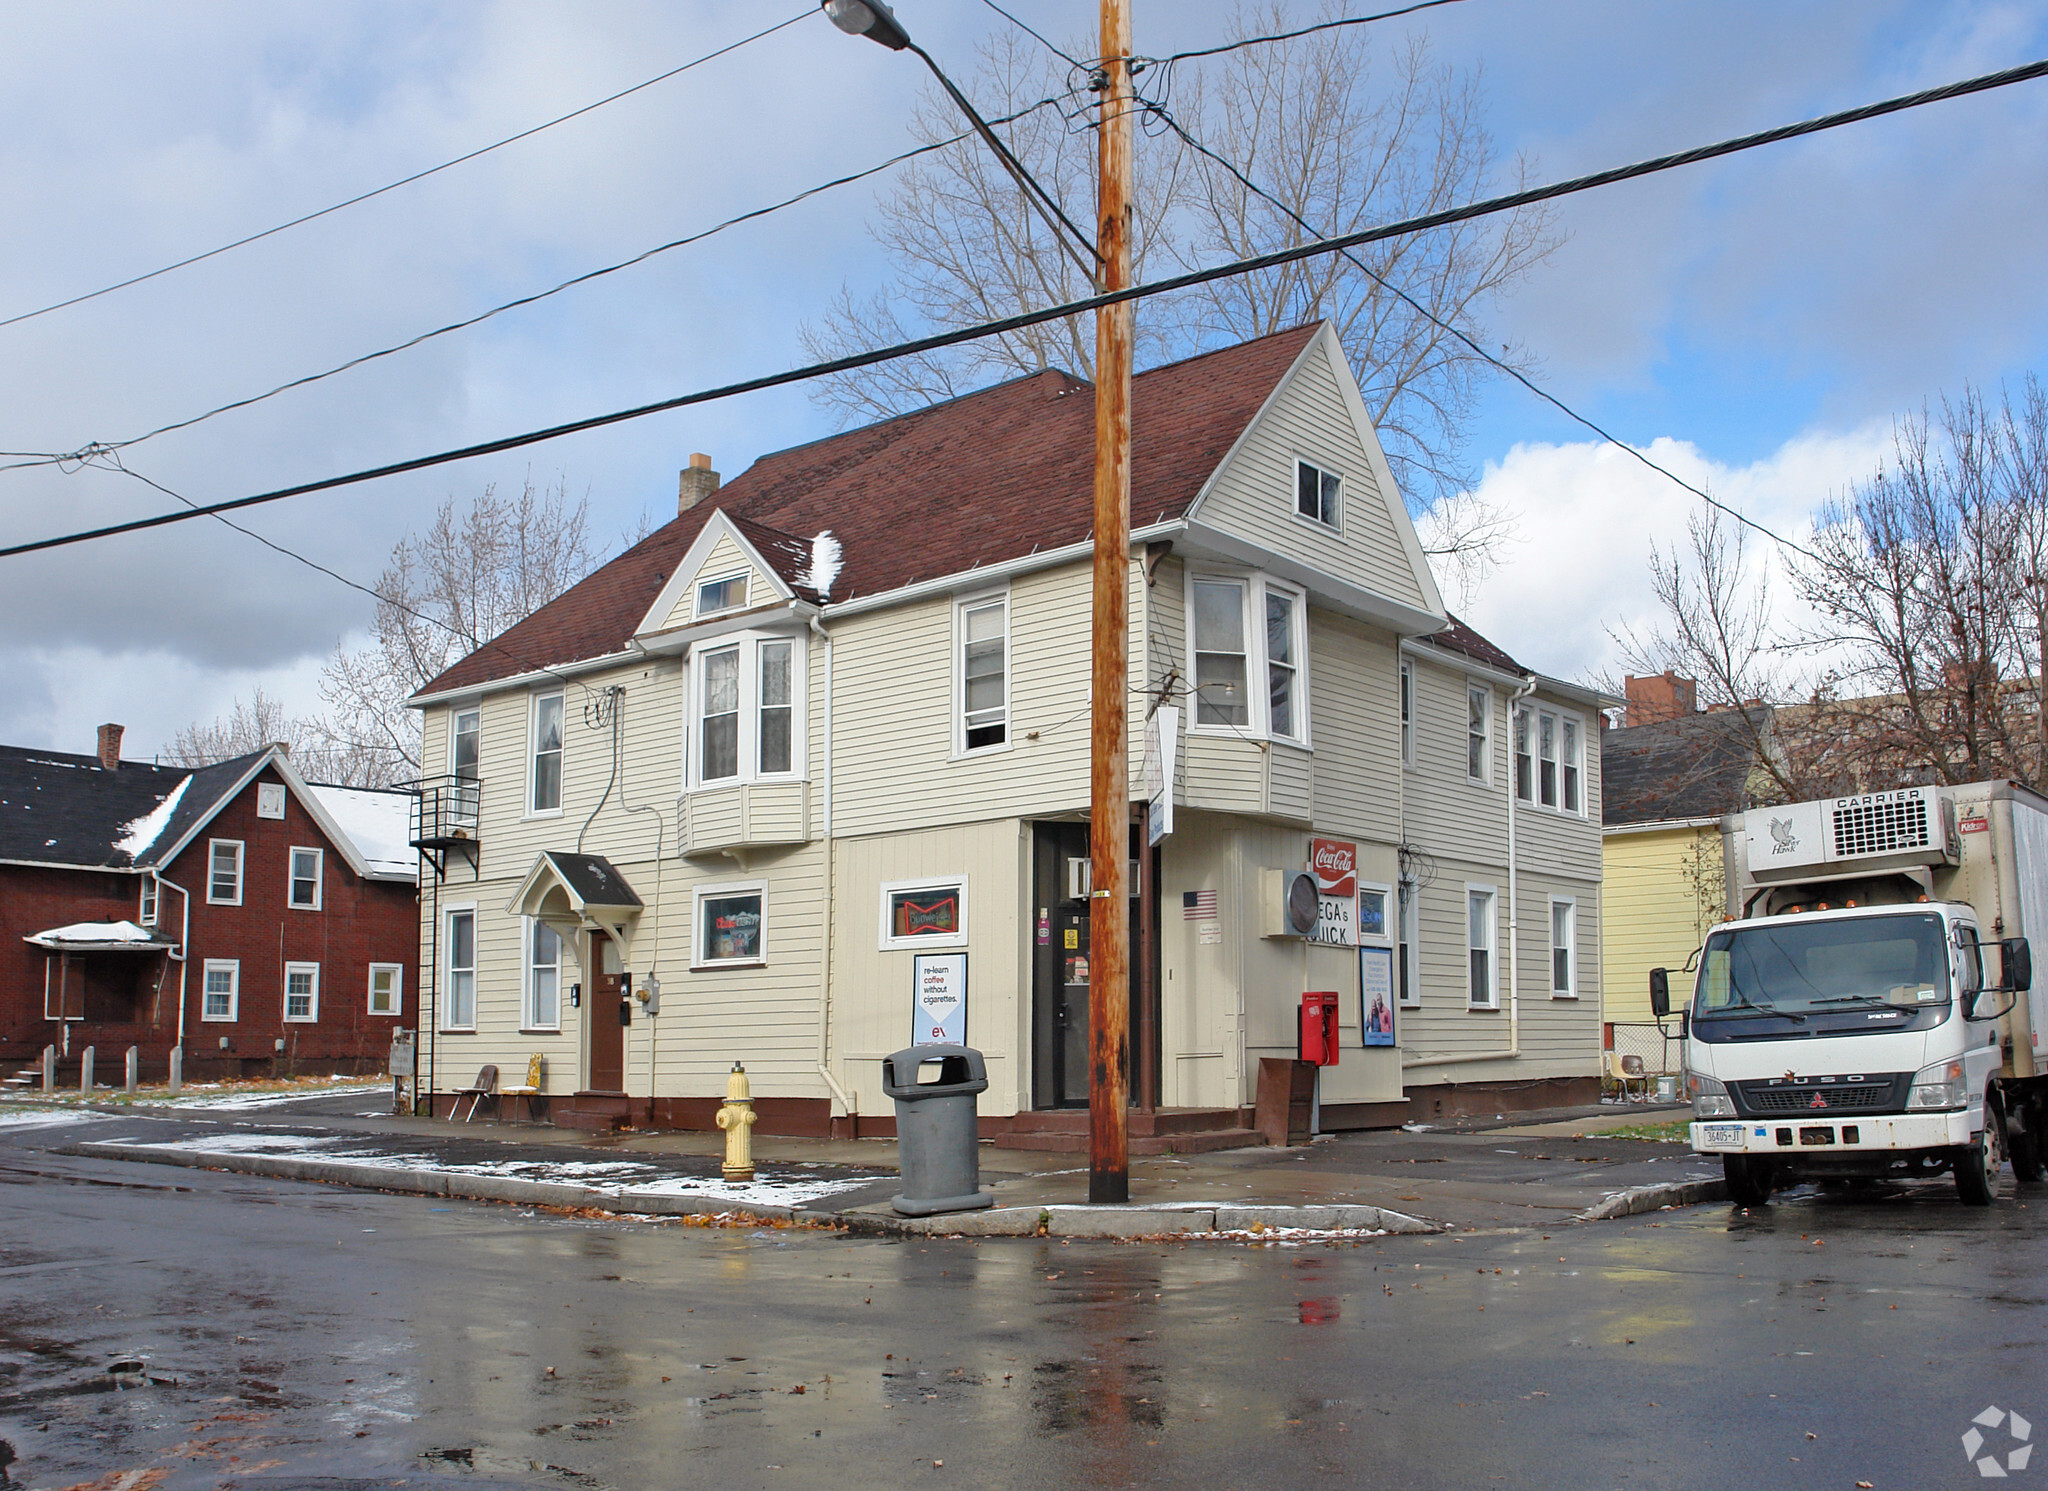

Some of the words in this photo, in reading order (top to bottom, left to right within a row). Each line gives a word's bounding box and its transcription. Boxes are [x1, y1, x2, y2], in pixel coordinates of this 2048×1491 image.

[1837, 790, 1920, 808] CARRIER
[1319, 901, 1349, 922] EGA's
[923, 966, 949, 975] re-learn
[923, 976, 944, 984] coffee
[923, 986, 947, 994] without
[923, 995, 957, 1006] cigarettes.
[1769, 1075, 1865, 1086] FUSO
